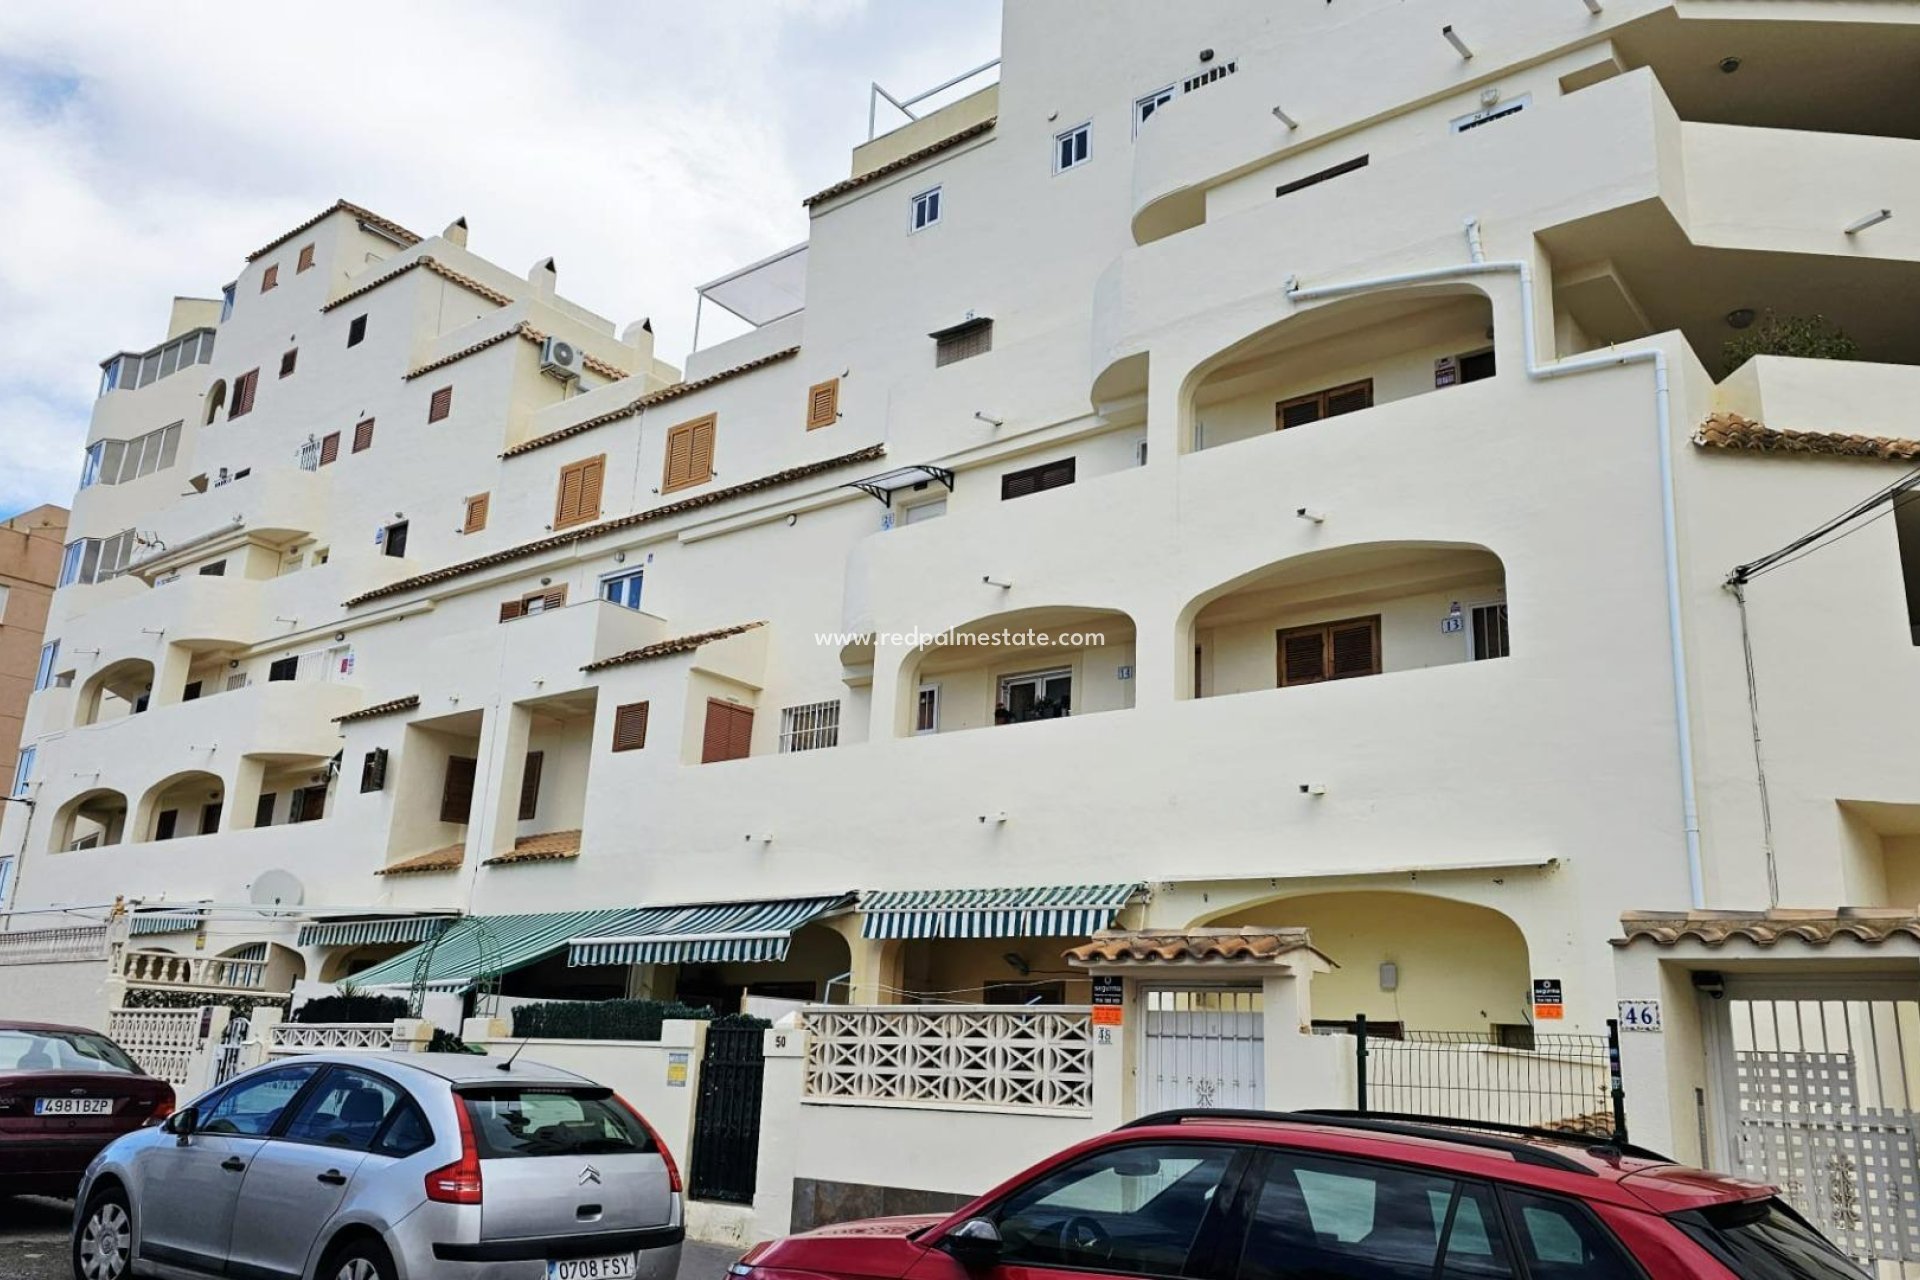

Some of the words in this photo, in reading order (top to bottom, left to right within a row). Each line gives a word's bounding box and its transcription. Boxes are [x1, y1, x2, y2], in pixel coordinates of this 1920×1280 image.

[1625, 1006, 1653, 1025] 46
[775, 1035, 786, 1048] 50
[45, 1100, 108, 1113] 4981BZP
[559, 1260, 598, 1280] 0708
[602, 1257, 629, 1276] FSY
